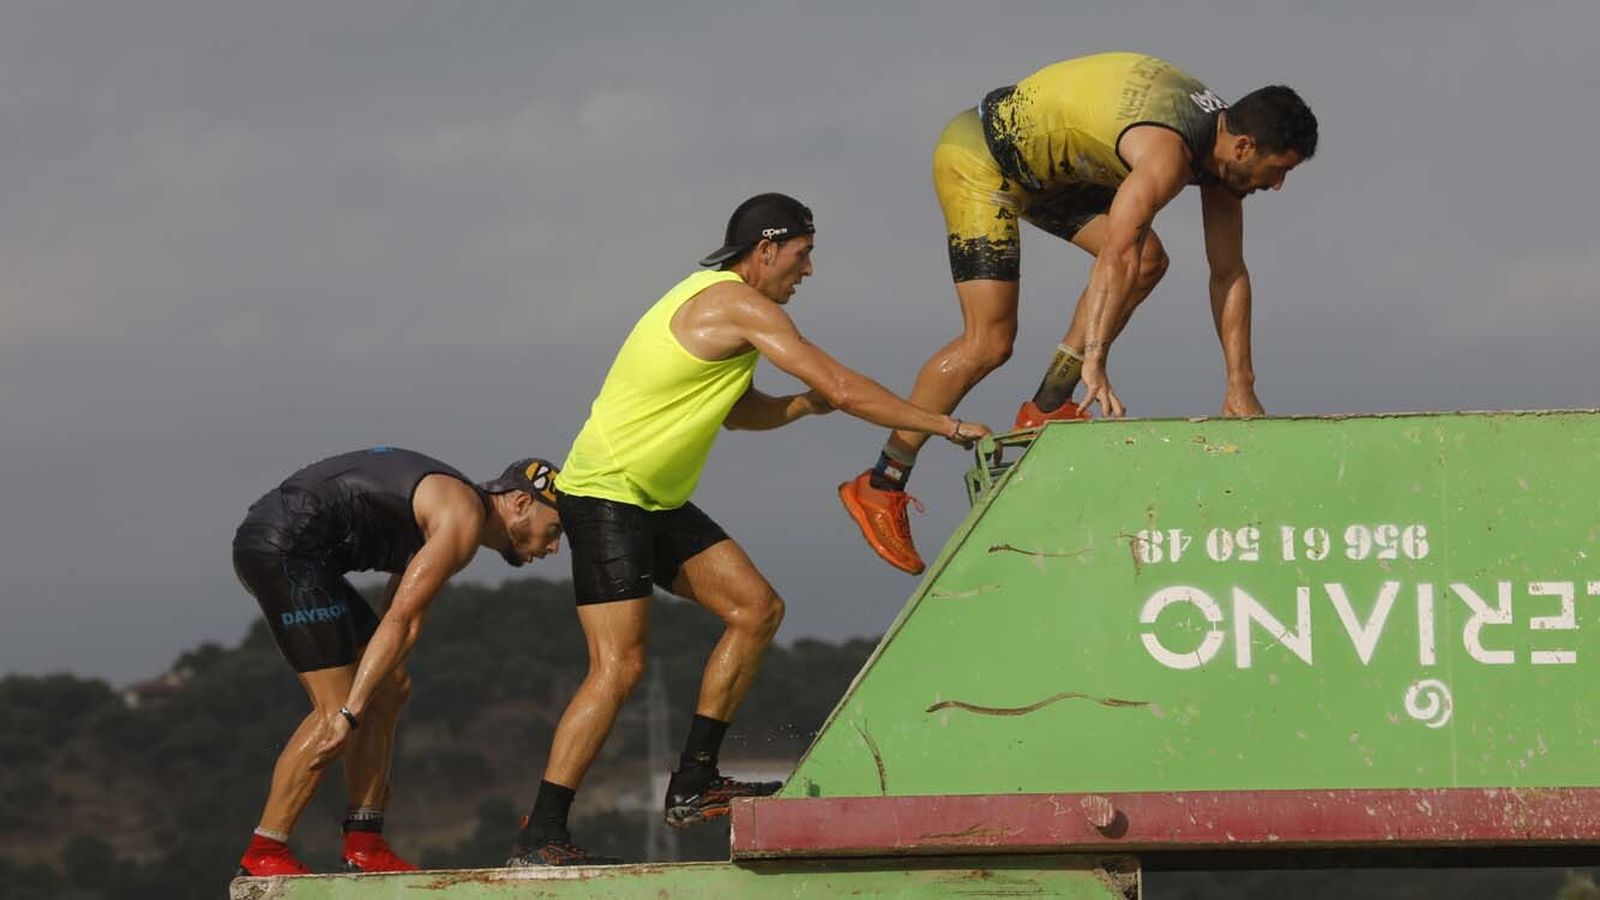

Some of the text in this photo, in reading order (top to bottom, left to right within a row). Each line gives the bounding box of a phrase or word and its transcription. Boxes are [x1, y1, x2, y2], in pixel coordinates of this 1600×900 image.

[1138, 524, 1430, 563] 956 61 50 48
[1139, 580, 1600, 670] ERIANO
